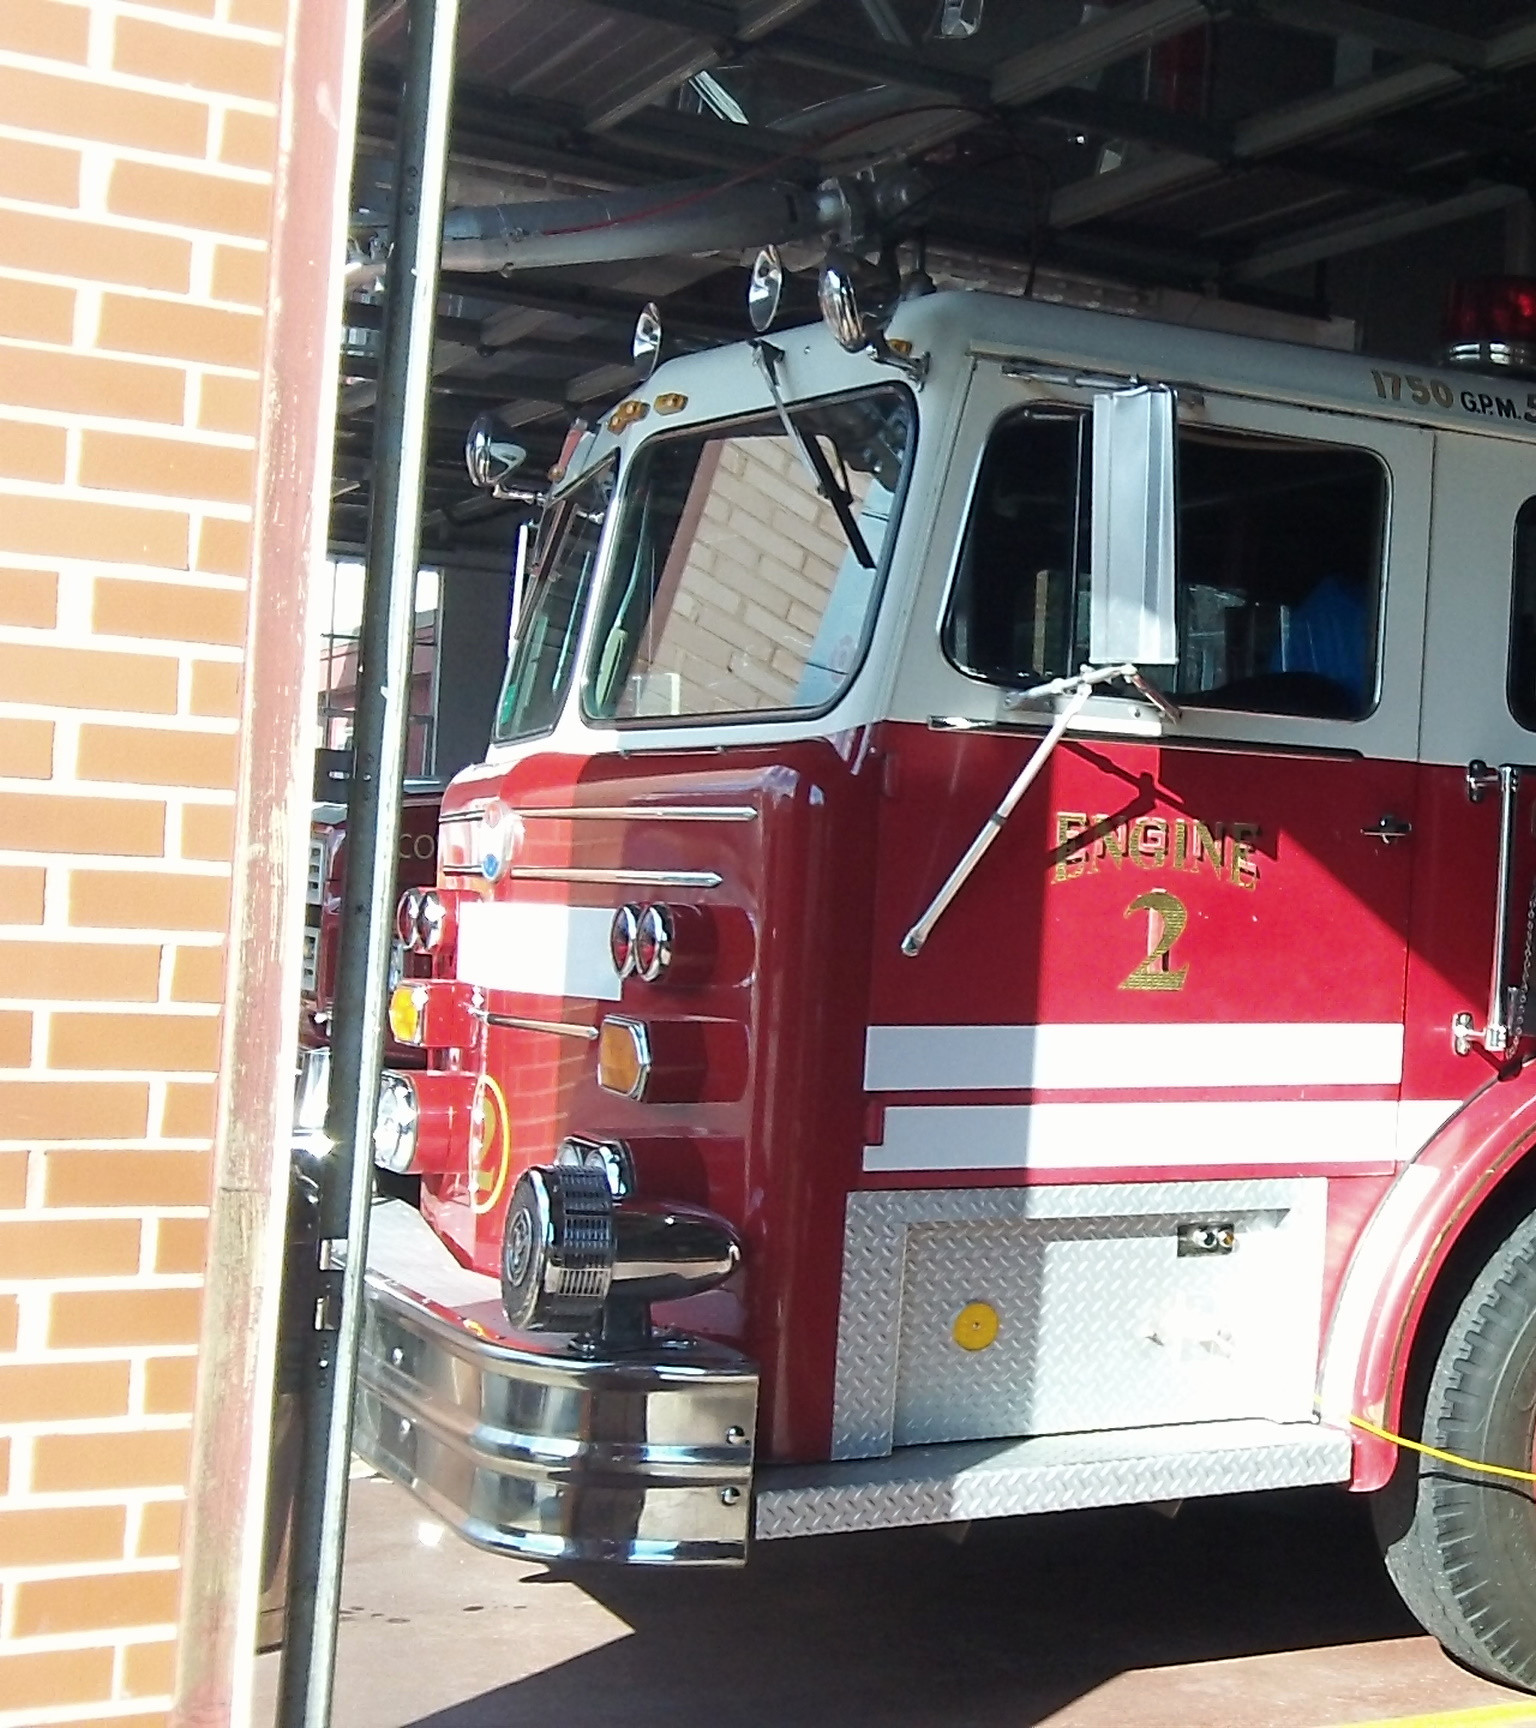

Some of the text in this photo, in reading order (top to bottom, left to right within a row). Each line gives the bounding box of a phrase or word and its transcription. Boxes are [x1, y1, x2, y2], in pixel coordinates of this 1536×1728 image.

[1372, 369, 1453, 409] 1750
[1052, 811, 1261, 890] ENGINE
[1117, 888, 1189, 991] 2
